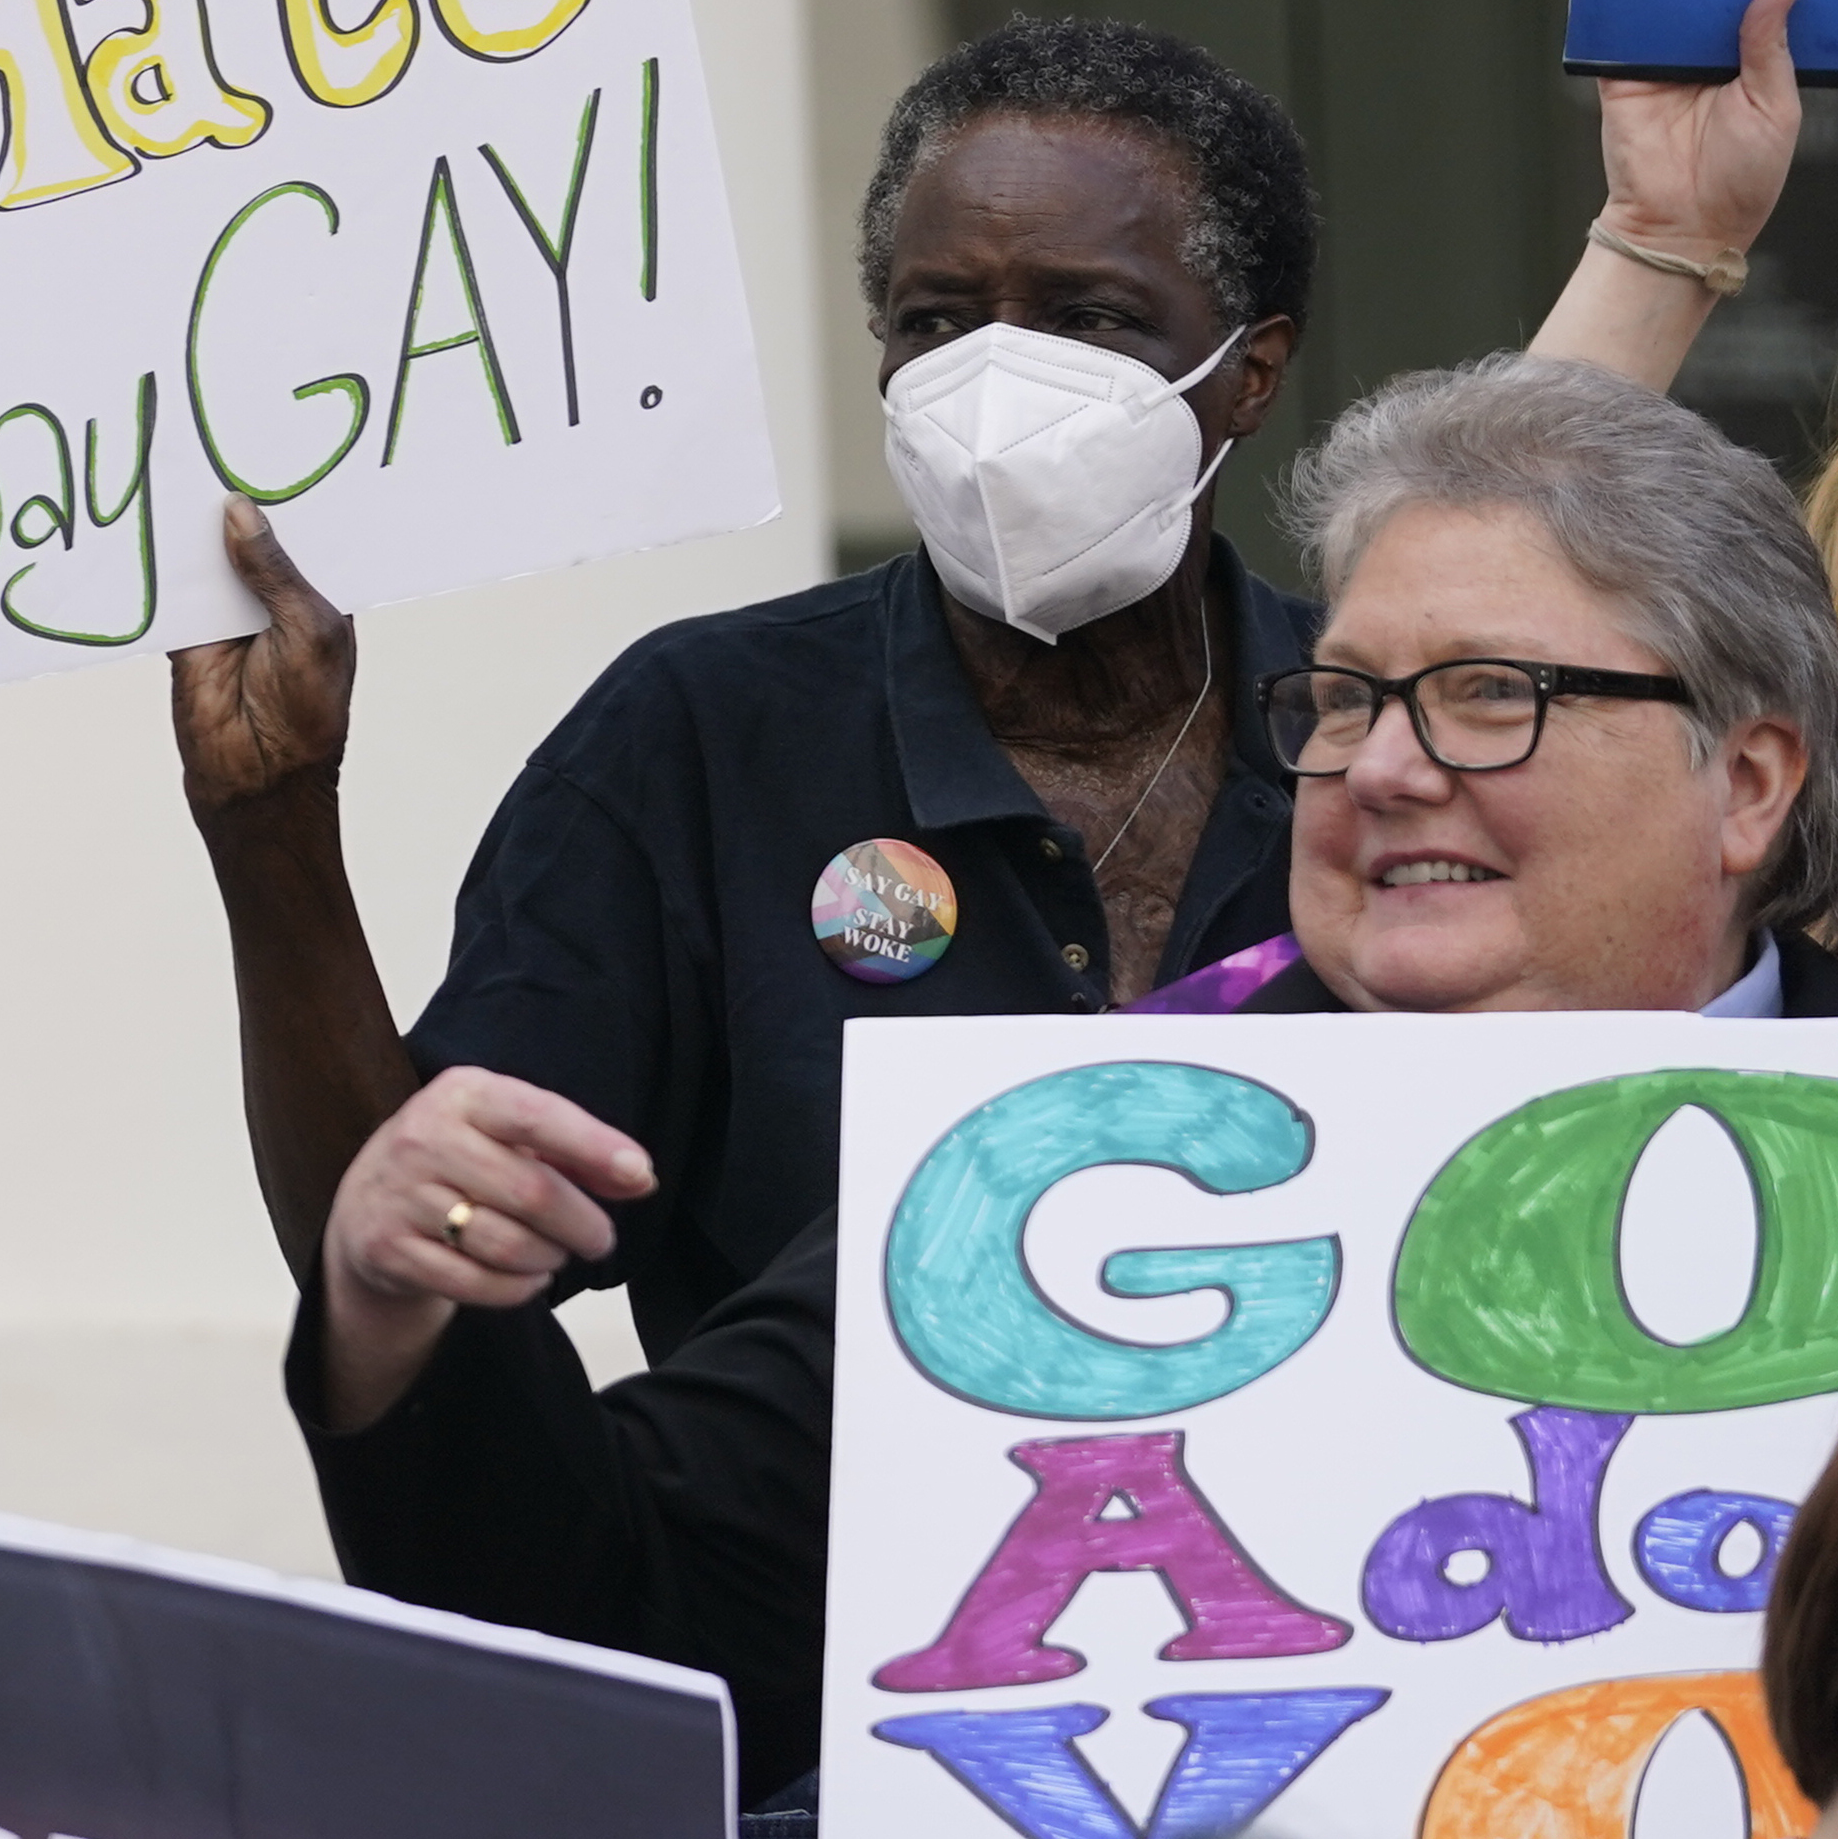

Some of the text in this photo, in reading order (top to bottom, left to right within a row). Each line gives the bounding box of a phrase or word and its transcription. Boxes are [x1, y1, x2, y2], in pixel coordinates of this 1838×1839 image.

[184, 57, 668, 506] GAY!
[845, 866, 945, 911] SAY GAY
[853, 908, 914, 939] STAY
[843, 926, 912, 963] WOKE
